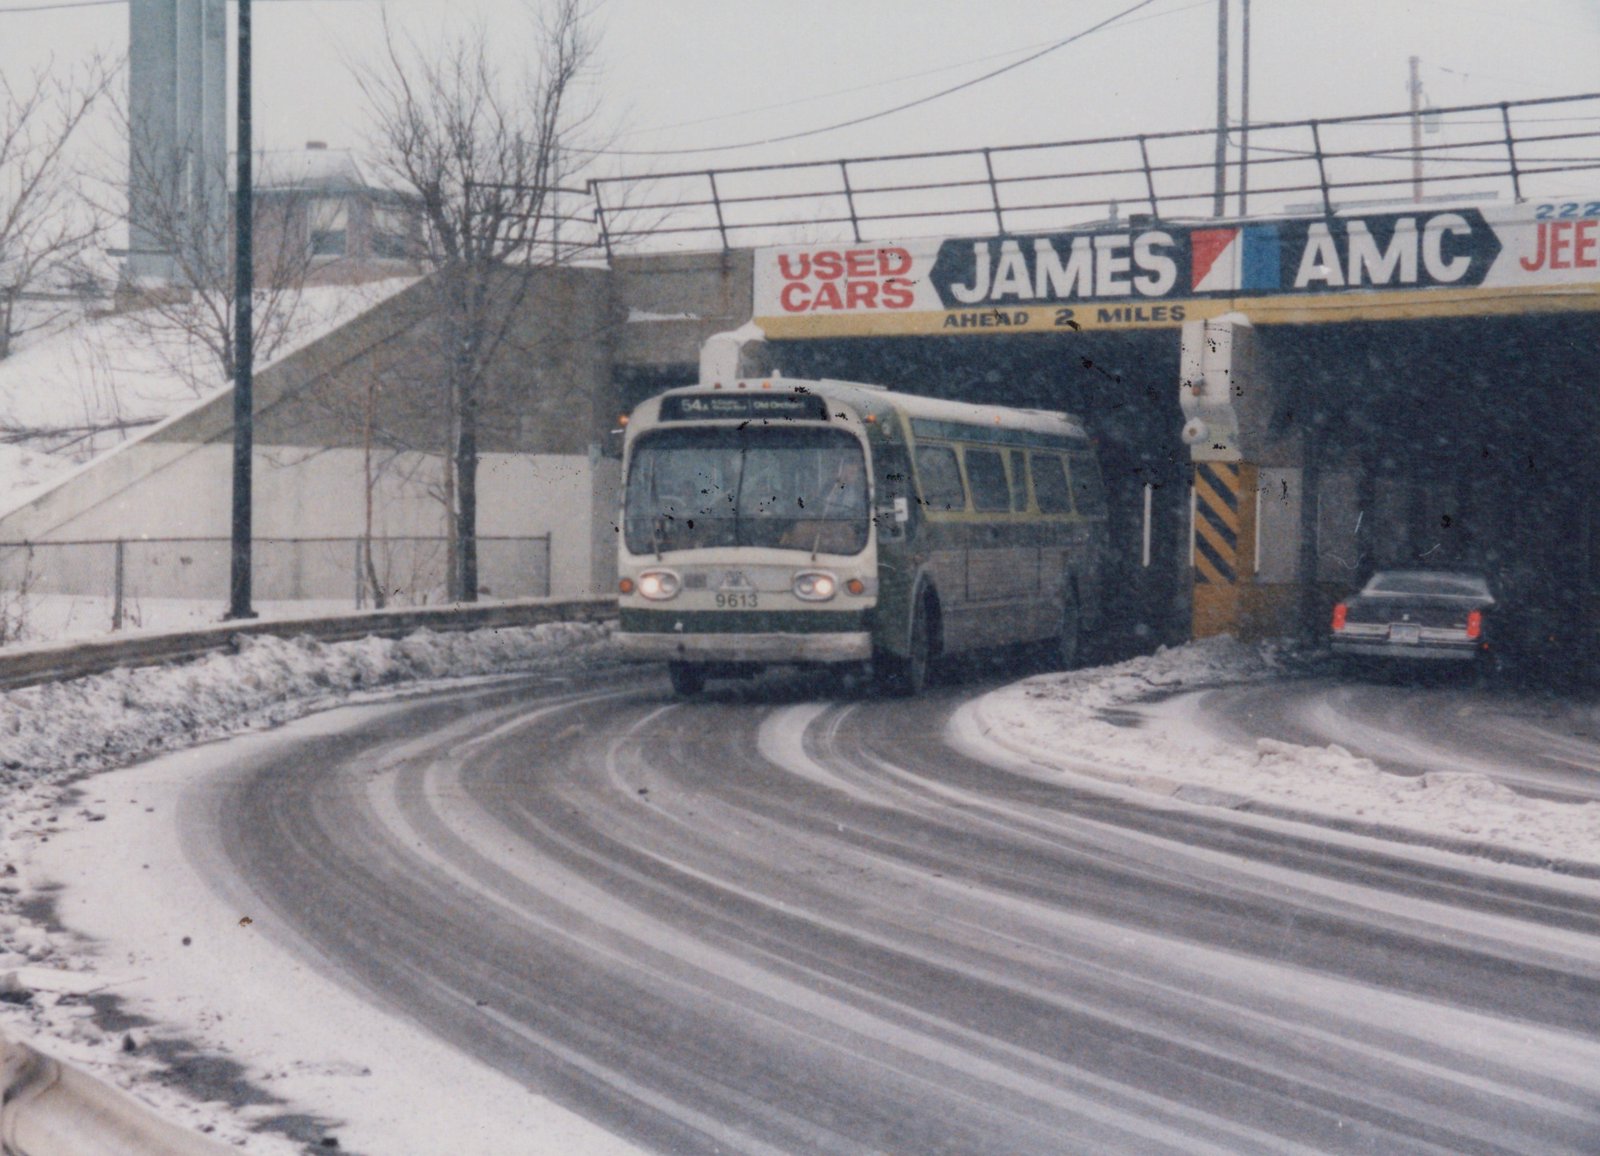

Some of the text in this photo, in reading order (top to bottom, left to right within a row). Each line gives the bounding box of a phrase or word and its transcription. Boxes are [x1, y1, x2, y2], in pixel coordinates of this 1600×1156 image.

[778, 247, 913, 280] USED
[951, 213, 1472, 303] JAMES AMC
[780, 278, 915, 312] CARS
[943, 305, 1186, 328] AHEAD 2 MILES
[716, 593, 758, 608] 9613
